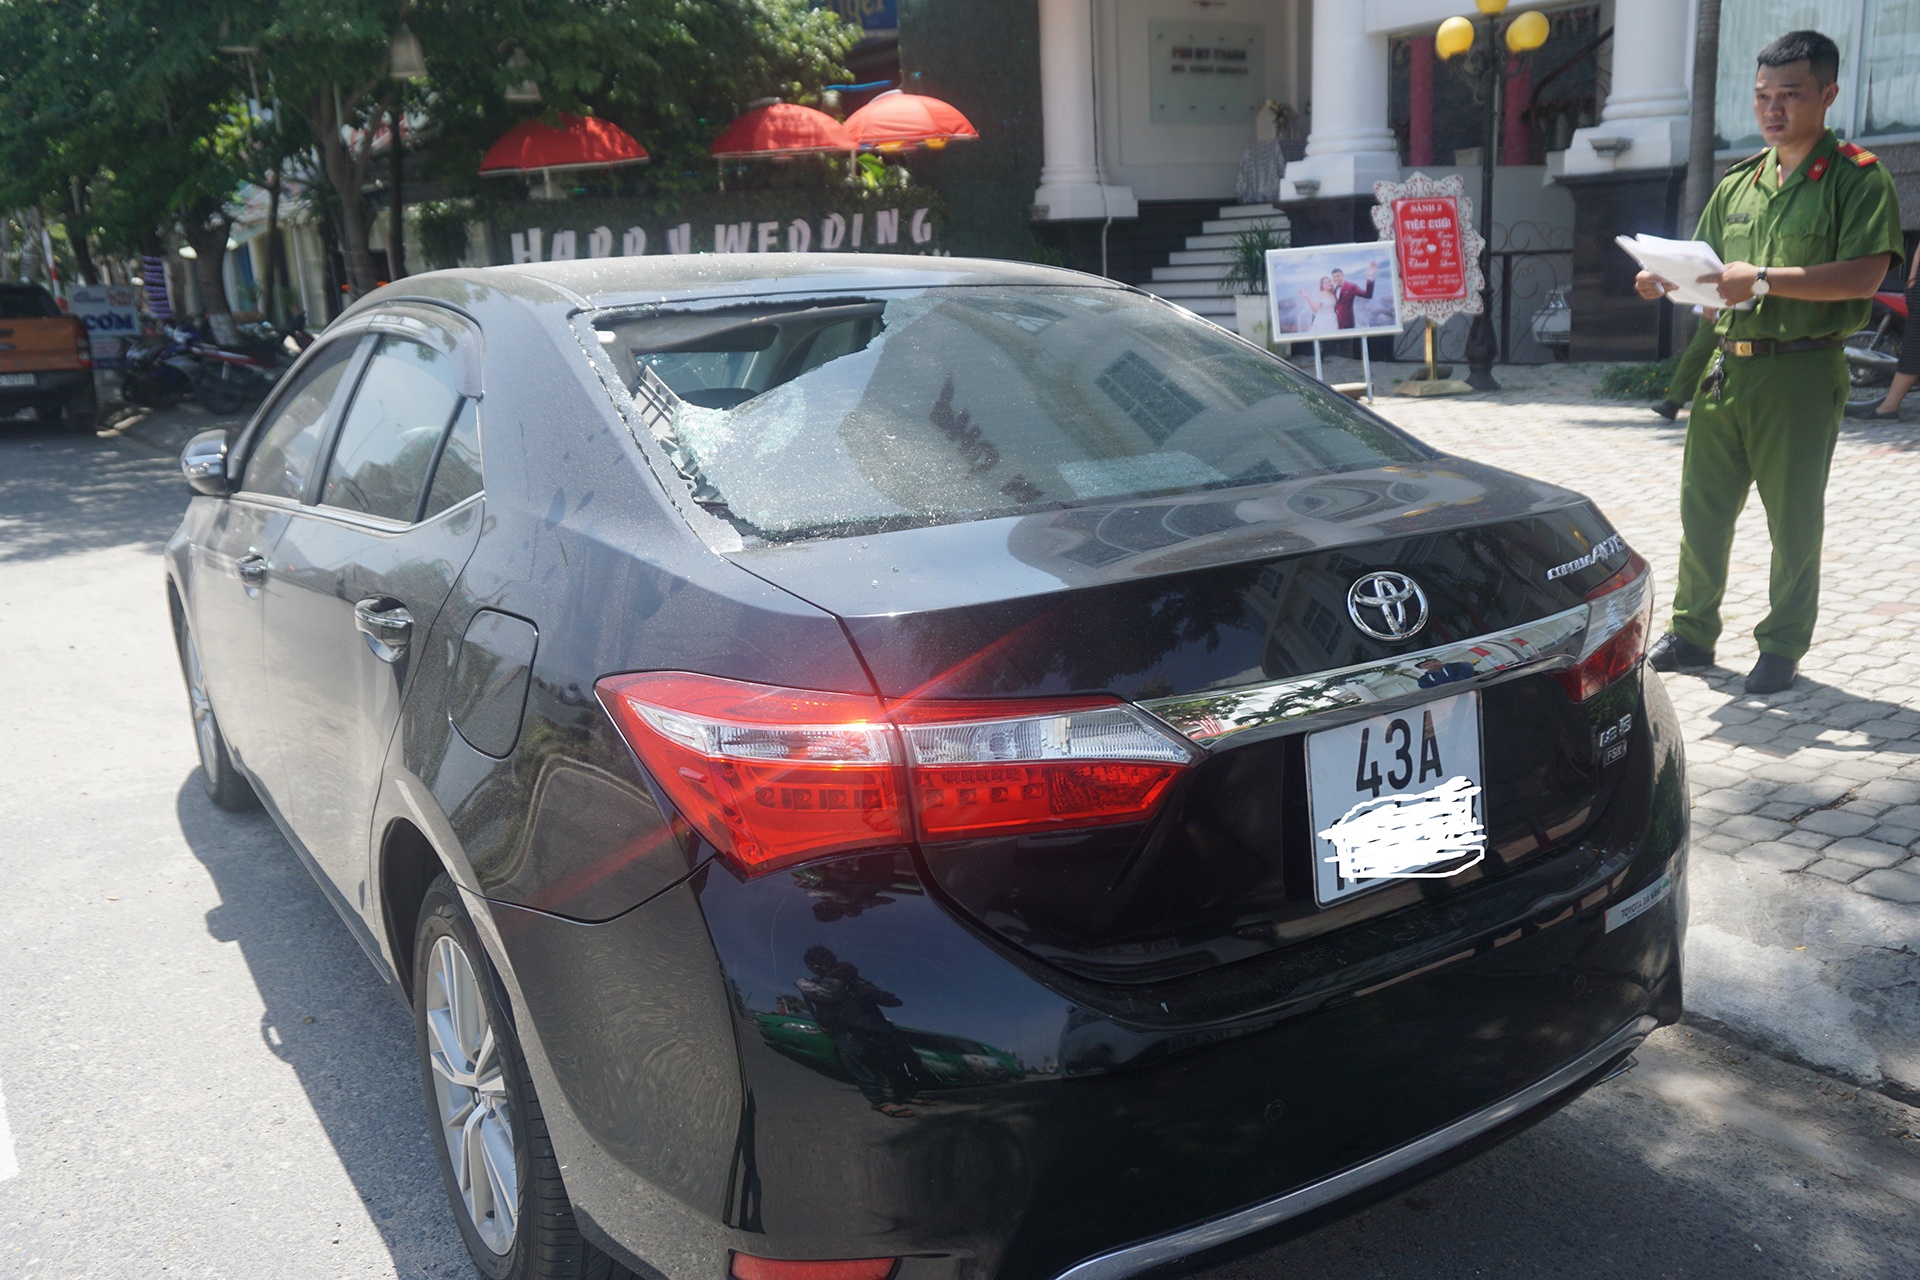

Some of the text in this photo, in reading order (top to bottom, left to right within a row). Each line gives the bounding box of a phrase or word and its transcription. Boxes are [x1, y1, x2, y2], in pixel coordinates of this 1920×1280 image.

[715, 207, 932, 253] WEDDING
[1356, 709, 1443, 797] 43A
[1620, 899, 1643, 918] TOYOTA
